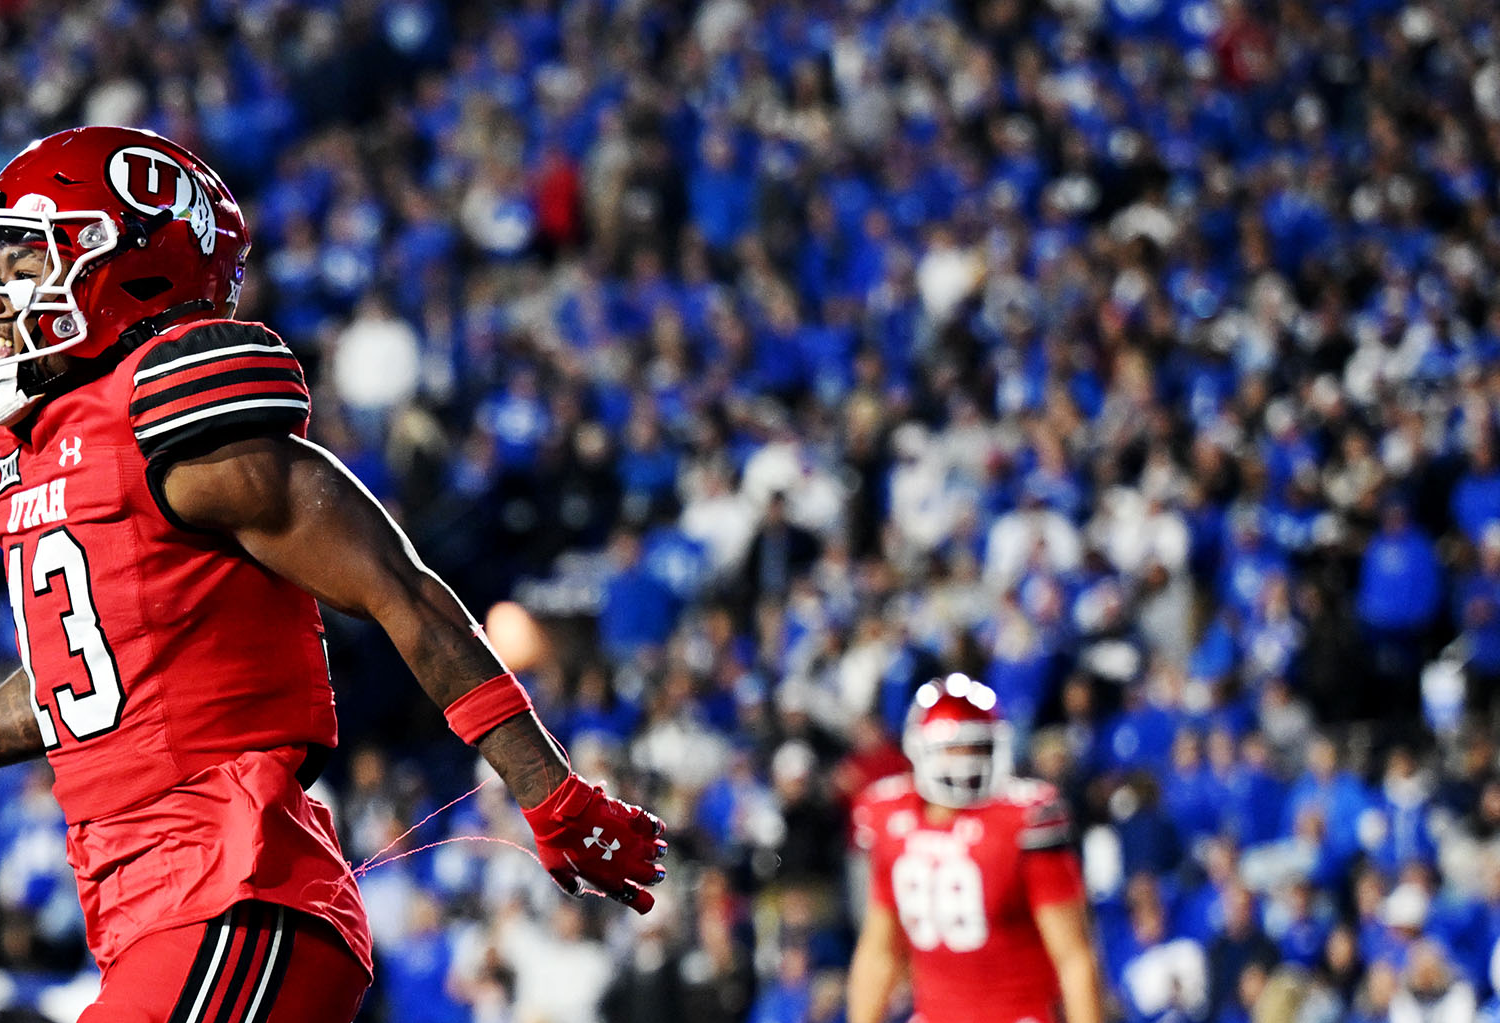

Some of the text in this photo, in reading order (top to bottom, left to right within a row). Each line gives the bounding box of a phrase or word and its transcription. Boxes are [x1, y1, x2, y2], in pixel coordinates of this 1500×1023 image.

[123, 152, 181, 209] U
[7, 478, 68, 533] UTAH
[8, 525, 127, 750] 13
